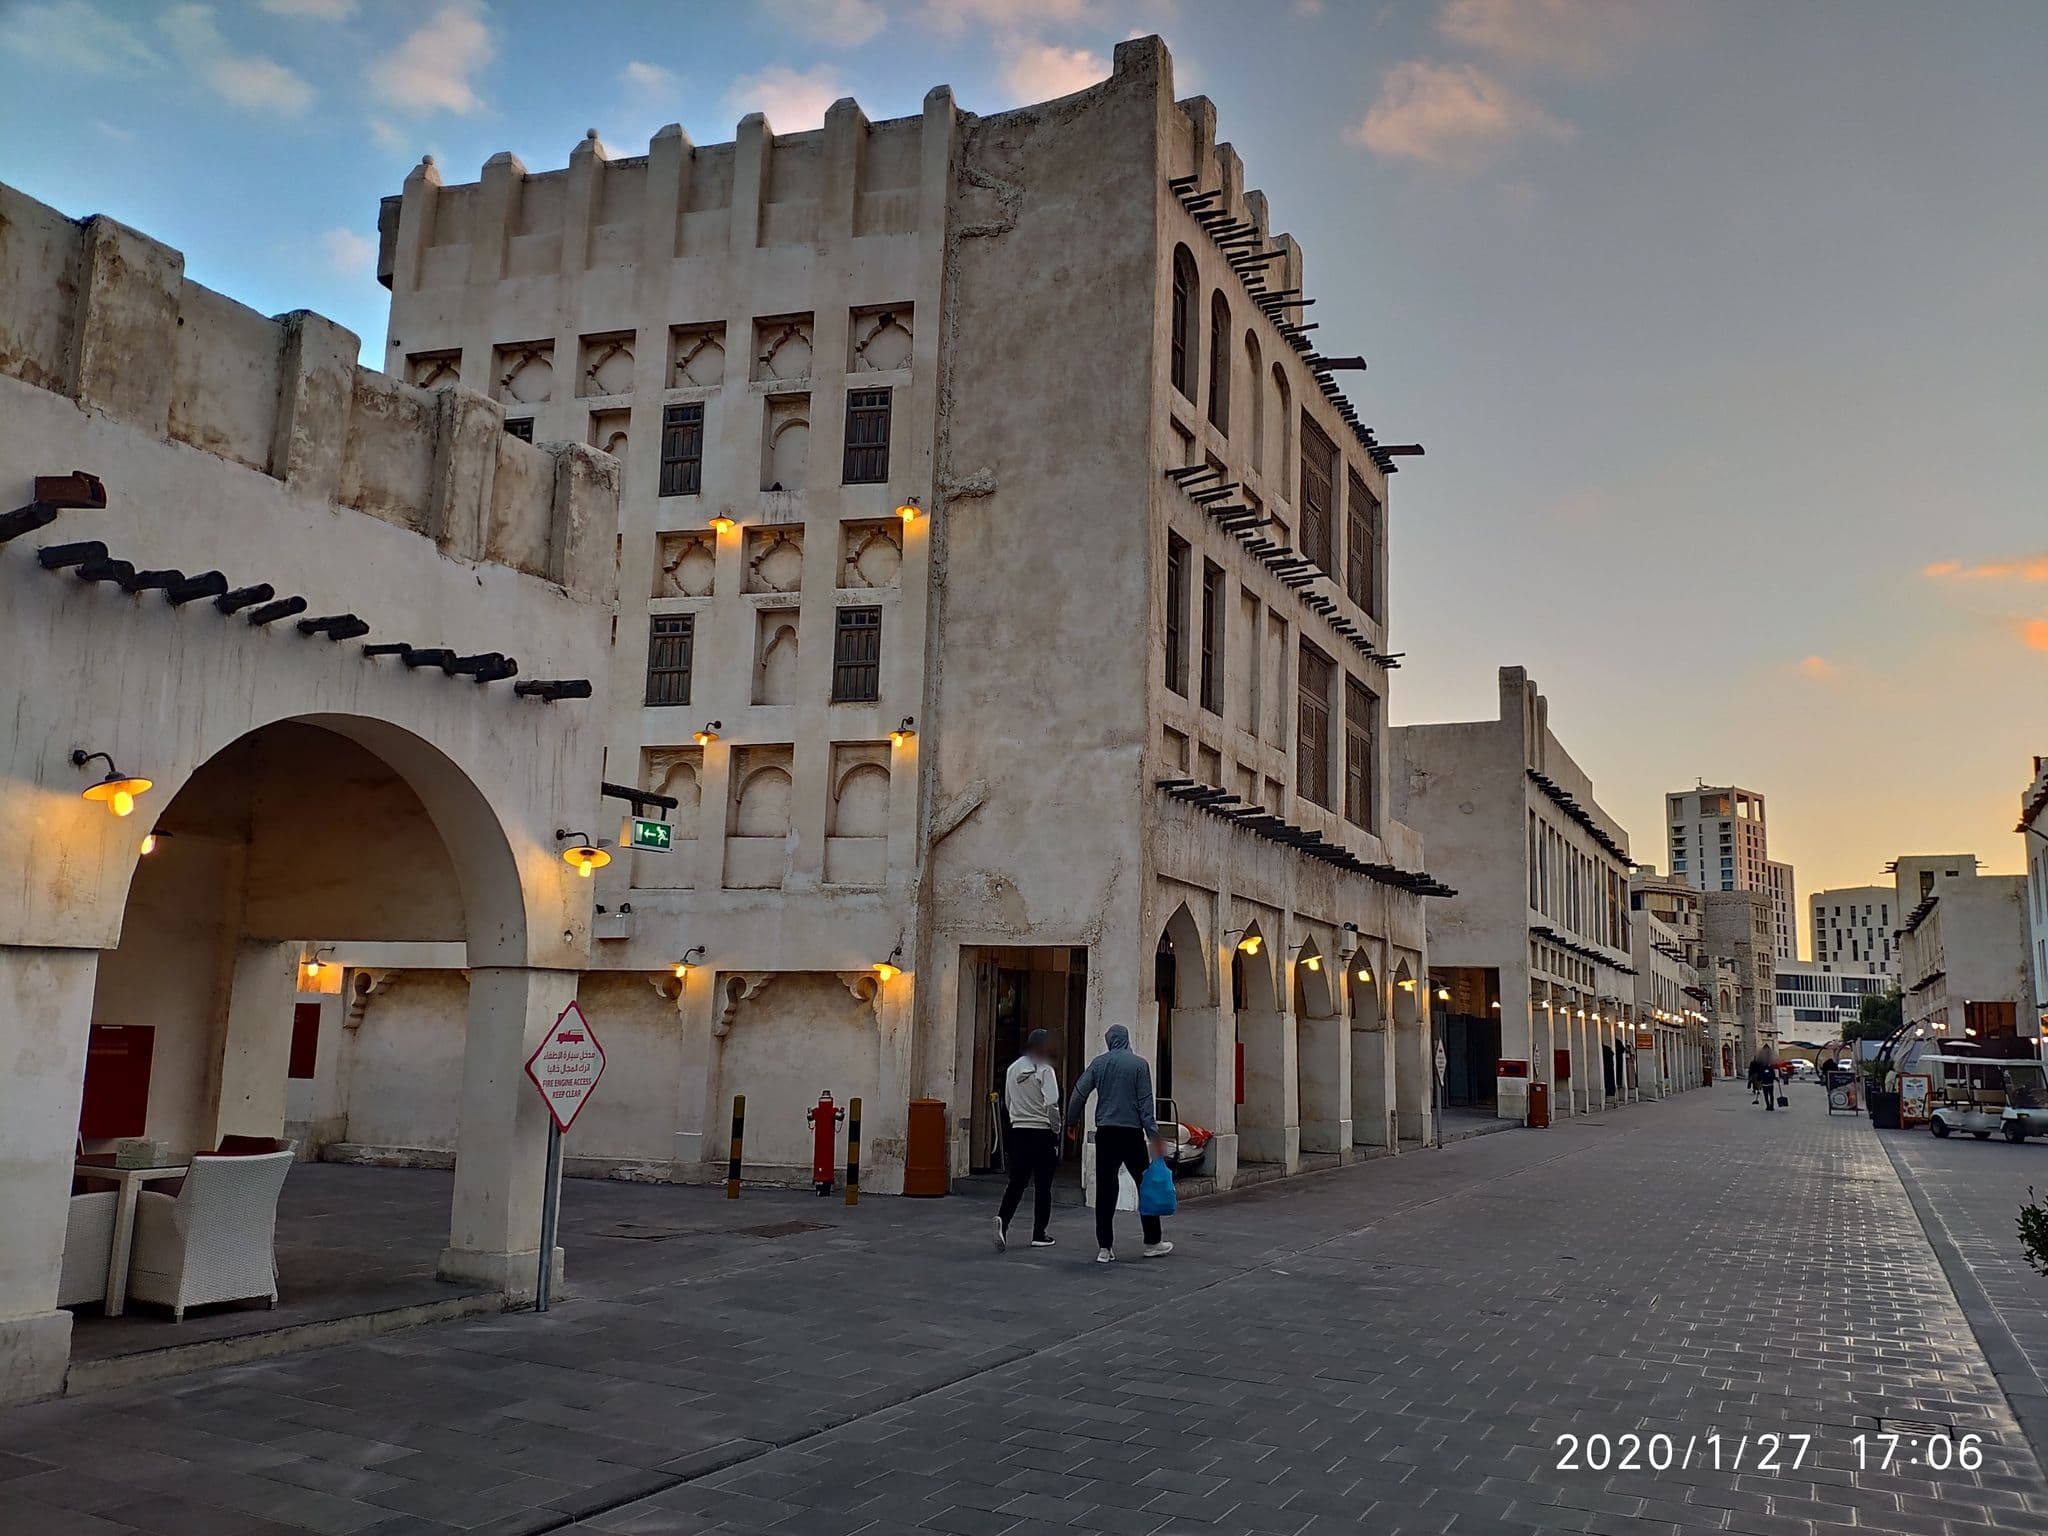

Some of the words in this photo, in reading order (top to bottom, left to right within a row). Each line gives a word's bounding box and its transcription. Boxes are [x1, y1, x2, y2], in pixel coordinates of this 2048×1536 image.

[563, 1051, 578, 1061] سيارة
[579, 1051, 595, 1061] مدخل
[554, 1078, 573, 1087] ENGINE
[552, 1090, 565, 1099] KEEP
[566, 1089, 581, 1098] CLEAR
